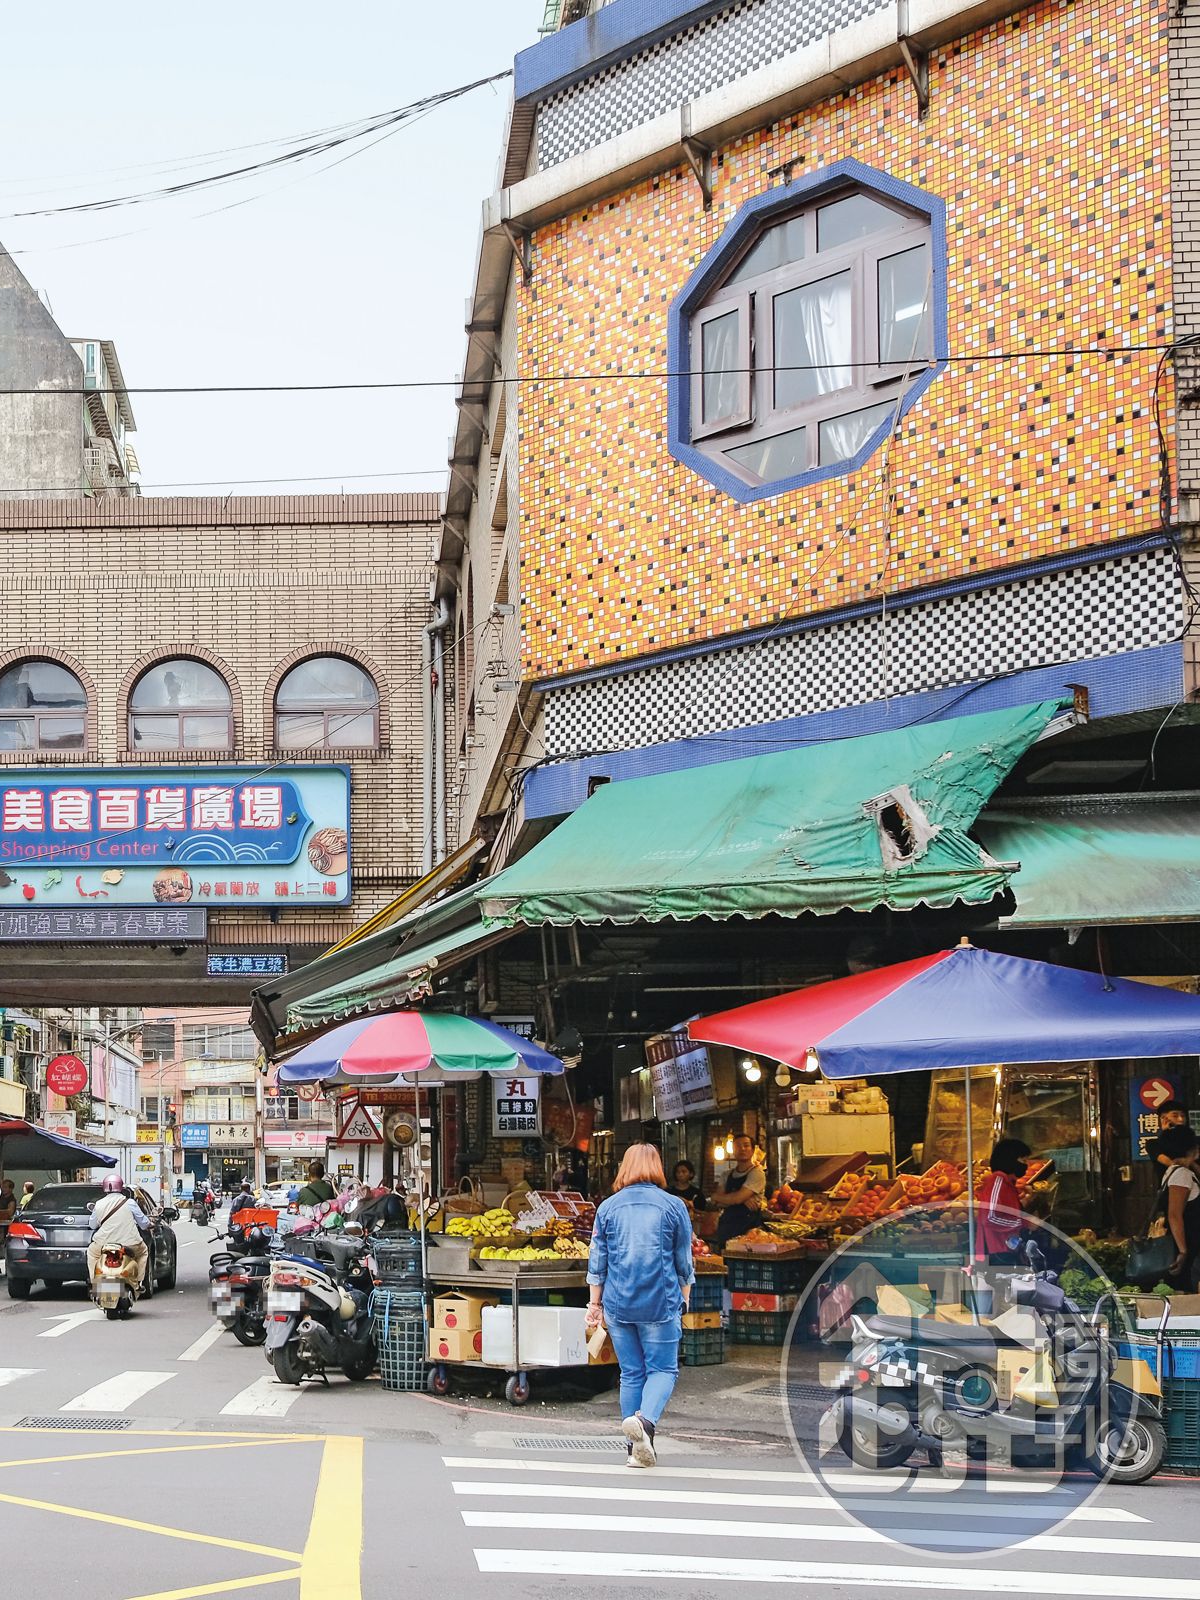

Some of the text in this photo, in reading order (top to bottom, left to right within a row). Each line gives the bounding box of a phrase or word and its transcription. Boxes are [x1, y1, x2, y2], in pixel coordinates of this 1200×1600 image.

[1, 840, 90, 861] Shopping
[96, 838, 159, 857] Center
[198, 881, 337, 897] 冷氣開放 請上二樓
[500, 1101, 534, 1113] 無摻粉
